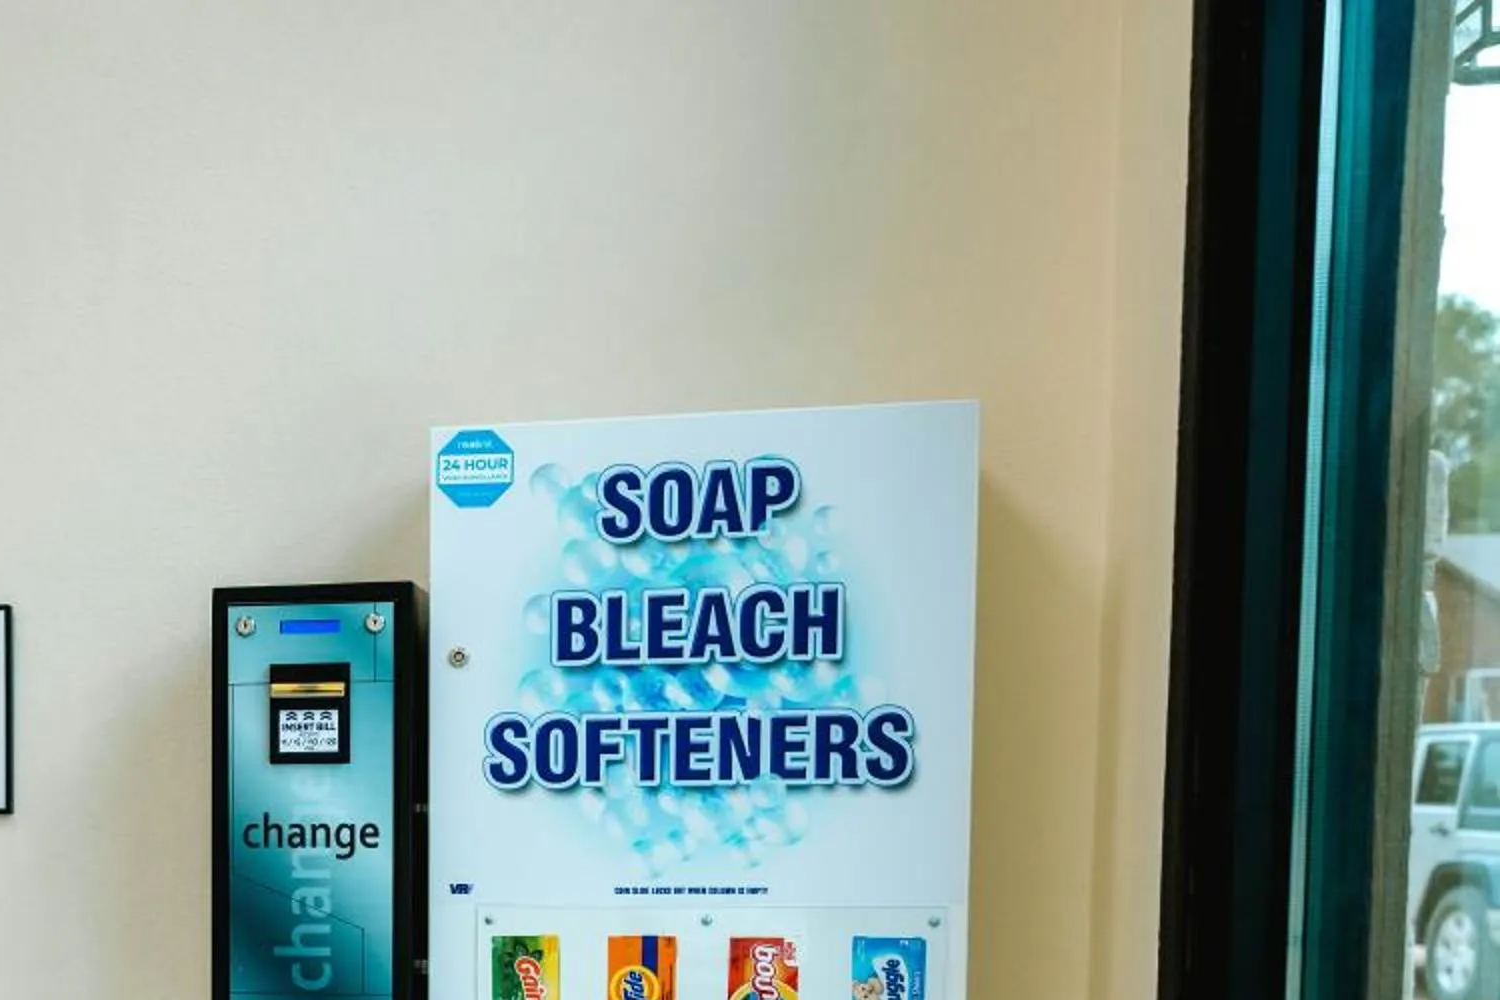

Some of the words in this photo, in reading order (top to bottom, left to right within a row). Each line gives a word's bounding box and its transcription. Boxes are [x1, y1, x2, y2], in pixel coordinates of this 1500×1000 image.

[442, 459, 461, 471] 24
[464, 457, 509, 471] HOUR
[599, 460, 799, 542] SOAP
[553, 584, 844, 665] BLEACH
[484, 705, 915, 788] SOFTENERS
[242, 812, 380, 860] change
